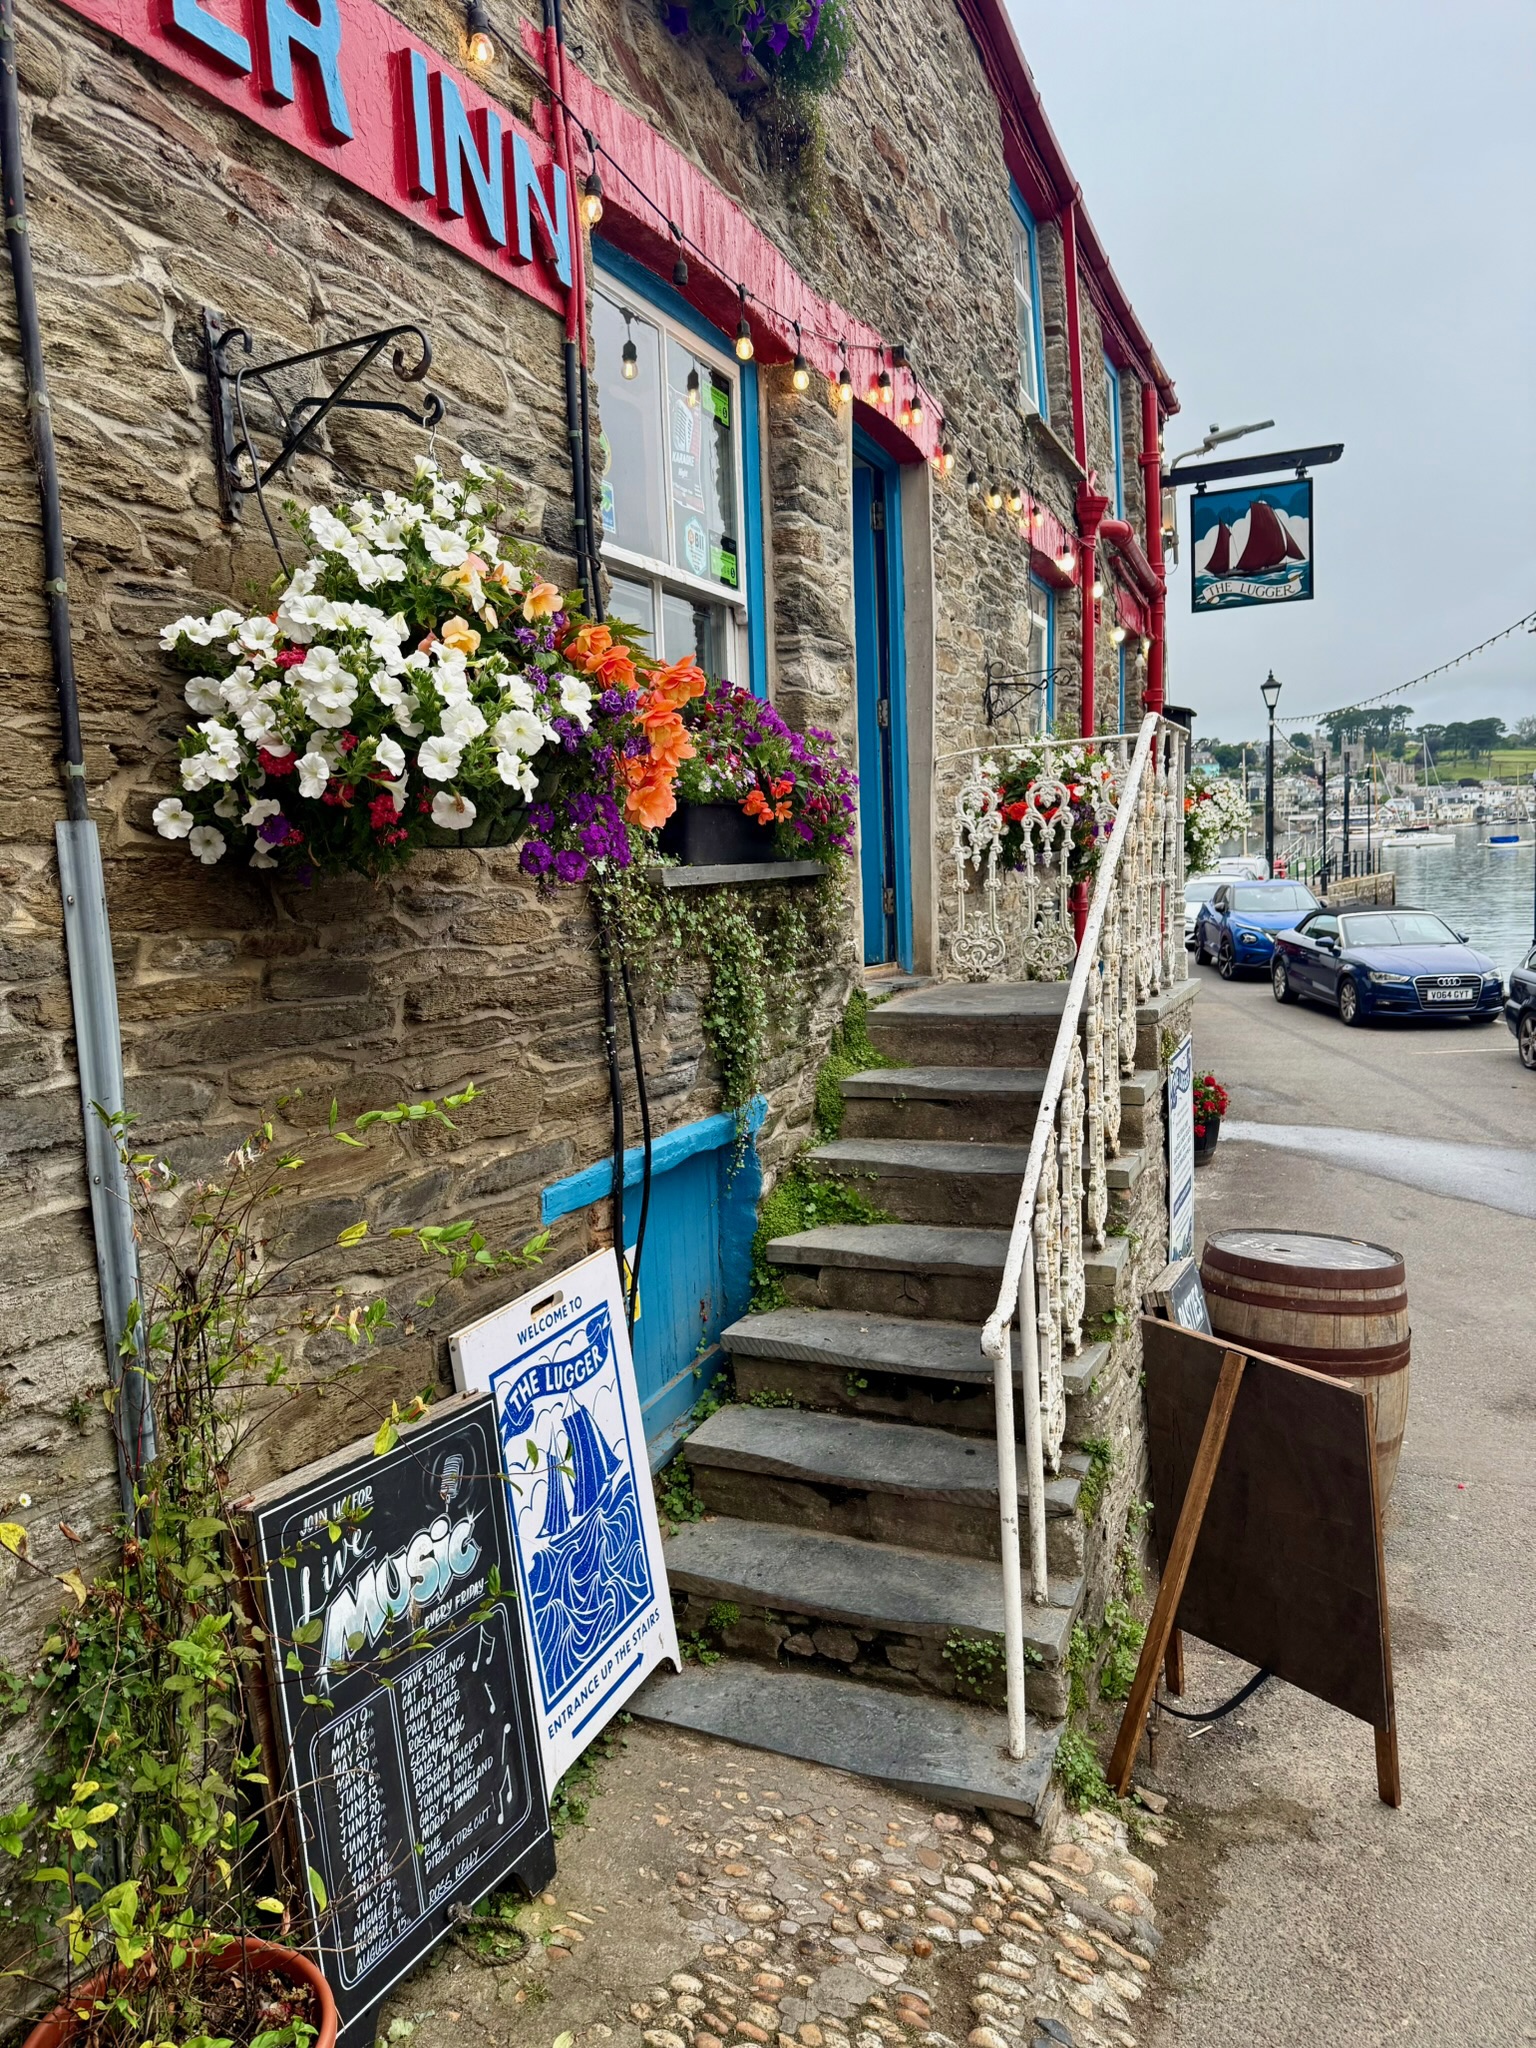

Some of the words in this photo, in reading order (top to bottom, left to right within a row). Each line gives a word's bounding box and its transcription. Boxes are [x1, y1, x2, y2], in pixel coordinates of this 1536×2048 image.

[402, 47, 571, 288] INN
[1206, 582, 1232, 596] THE
[1240, 583, 1295, 597] LUGGER
[517, 1304, 568, 1345] WELCOME
[569, 1296, 582, 1312] TO
[509, 1369, 540, 1412] THE
[545, 1345, 603, 1391] LUGGER
[299, 1508, 328, 1537] JOIN
[352, 1485, 373, 1511] FOR
[296, 1528, 374, 1625] Live
[424, 1603, 453, 1628] EVERY
[401, 1666, 424, 1694] DAVE
[426, 1649, 446, 1675] RICH
[402, 1686, 418, 1710] CAT
[422, 1652, 466, 1694] FLORENCE
[547, 1675, 600, 1740] ENTRANCE
[600, 1660, 613, 1680] UP
[614, 1640, 632, 1665] THE
[632, 1608, 660, 1646] STAIRS
[405, 1693, 433, 1725] LAURA
[436, 1675, 457, 1700] KATE
[406, 1714, 428, 1740] PAUL
[431, 1690, 460, 1721] ARMER
[331, 1735, 352, 1764] MAY
[333, 1712, 358, 1744] MAY
[408, 1725, 431, 1754] ROSS
[433, 1704, 457, 1735] KELLY
[411, 1731, 446, 1771] SEAMUS
[448, 1714, 465, 1740] MAC
[333, 1752, 353, 1780] MAY
[412, 1751, 438, 1784] DAISY
[441, 1735, 459, 1761] MAE
[415, 1759, 451, 1799] REBECCA
[452, 1729, 484, 1767] PUCKEY
[418, 1775, 450, 1812] JOANNA
[454, 1756, 474, 1782] COOK
[338, 1775, 366, 1810] JUNE
[339, 1792, 367, 1827] JUNE
[419, 1799, 440, 1828] GARY
[422, 1805, 451, 1842] MOREY
[454, 1781, 479, 1812] DAMON
[340, 1809, 368, 1843] JUNE
[342, 1826, 369, 1860] JUNE
[425, 1822, 473, 1875] DIRECTORS
[474, 1805, 491, 1829] CUT
[425, 1832, 441, 1859] RUE
[347, 1840, 372, 1873] JULY
[351, 1855, 375, 1887] JULY
[429, 1872, 452, 1905] ROSS
[455, 1846, 479, 1880] KELLY
[353, 1895, 390, 1941] AUGUST
[356, 1886, 380, 1919] JULY
[356, 1924, 395, 1975] AUGUST
